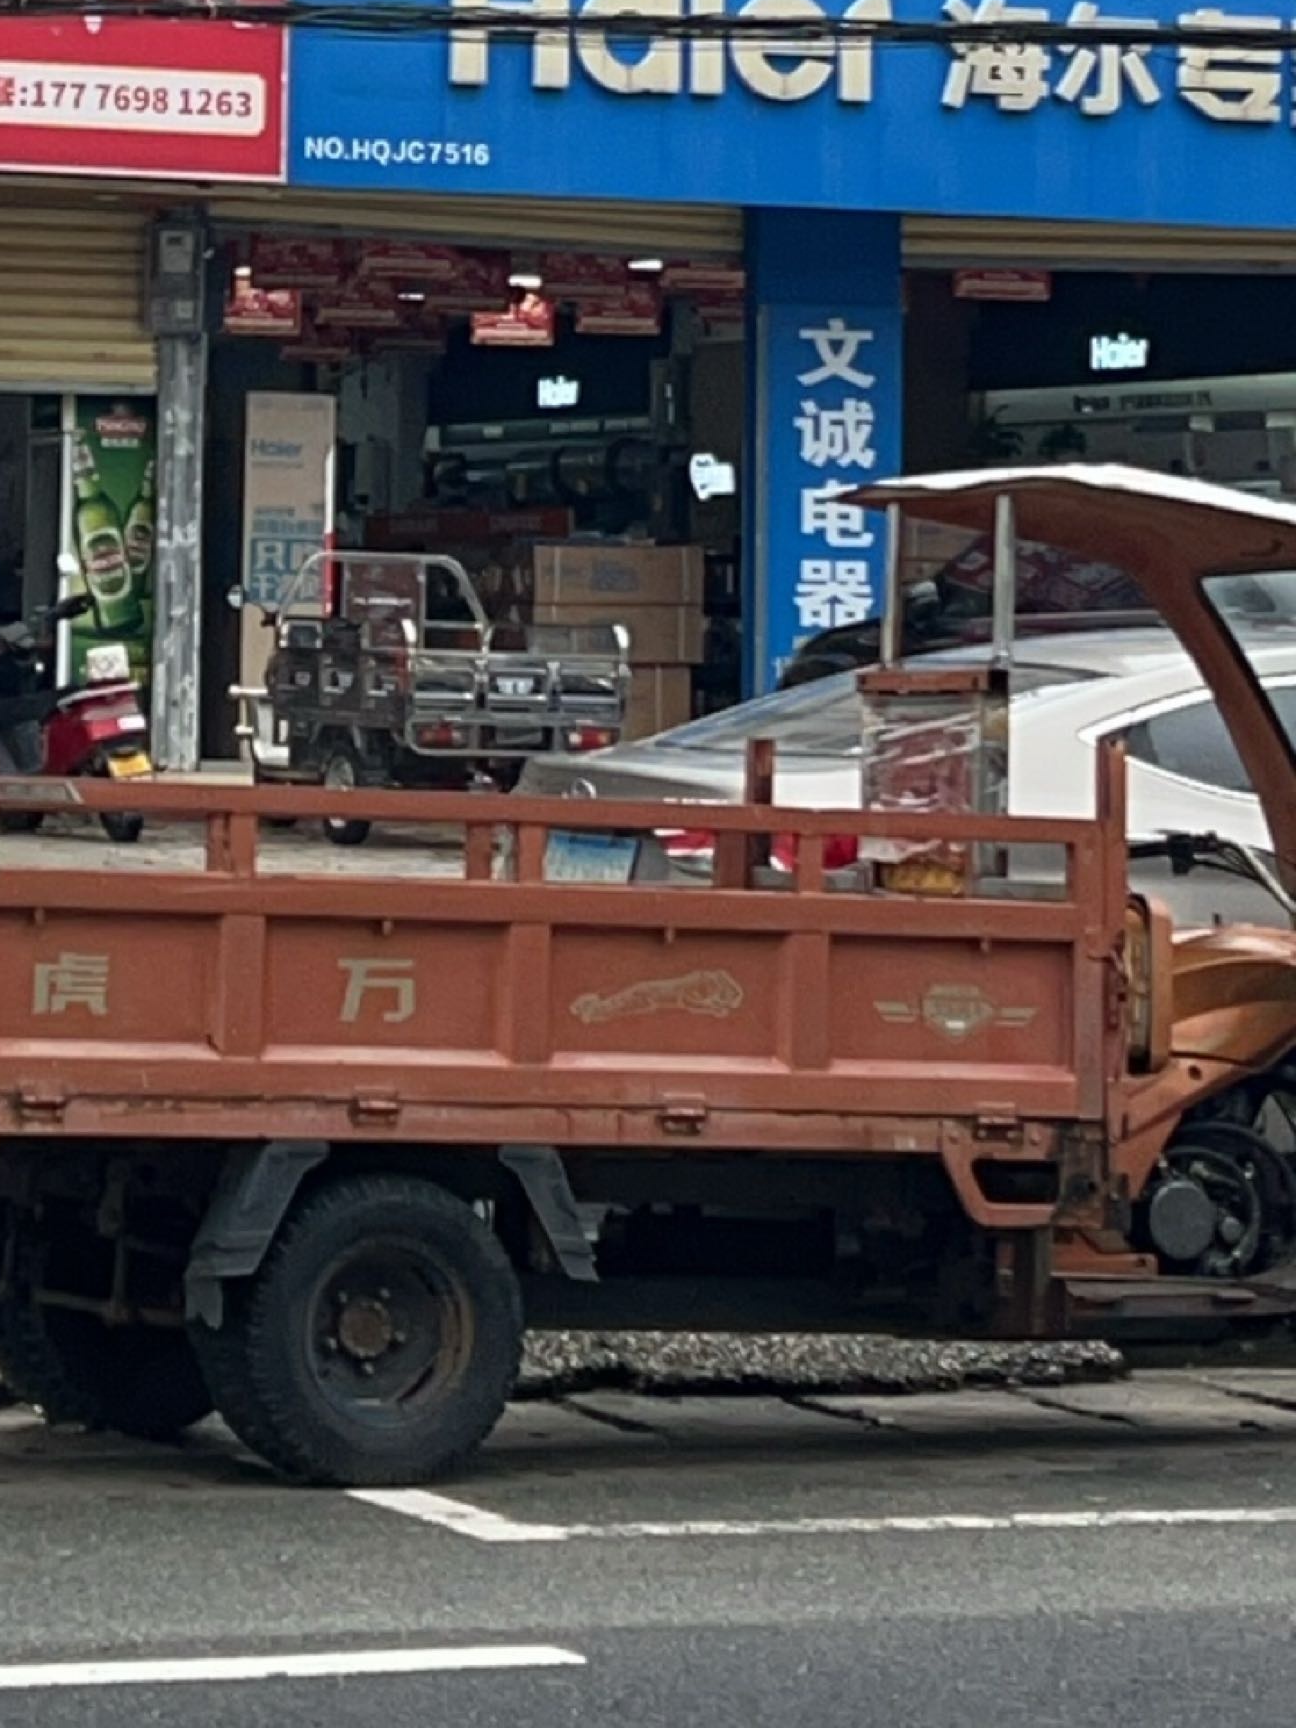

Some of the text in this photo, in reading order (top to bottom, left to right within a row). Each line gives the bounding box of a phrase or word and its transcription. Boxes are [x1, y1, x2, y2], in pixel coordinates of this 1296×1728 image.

[95, 83, 169, 114] 7698
[178, 89, 253, 118] 1263
[793, 318, 876, 628] 文诚电器
[31, 952, 415, 1023] 虎 万
